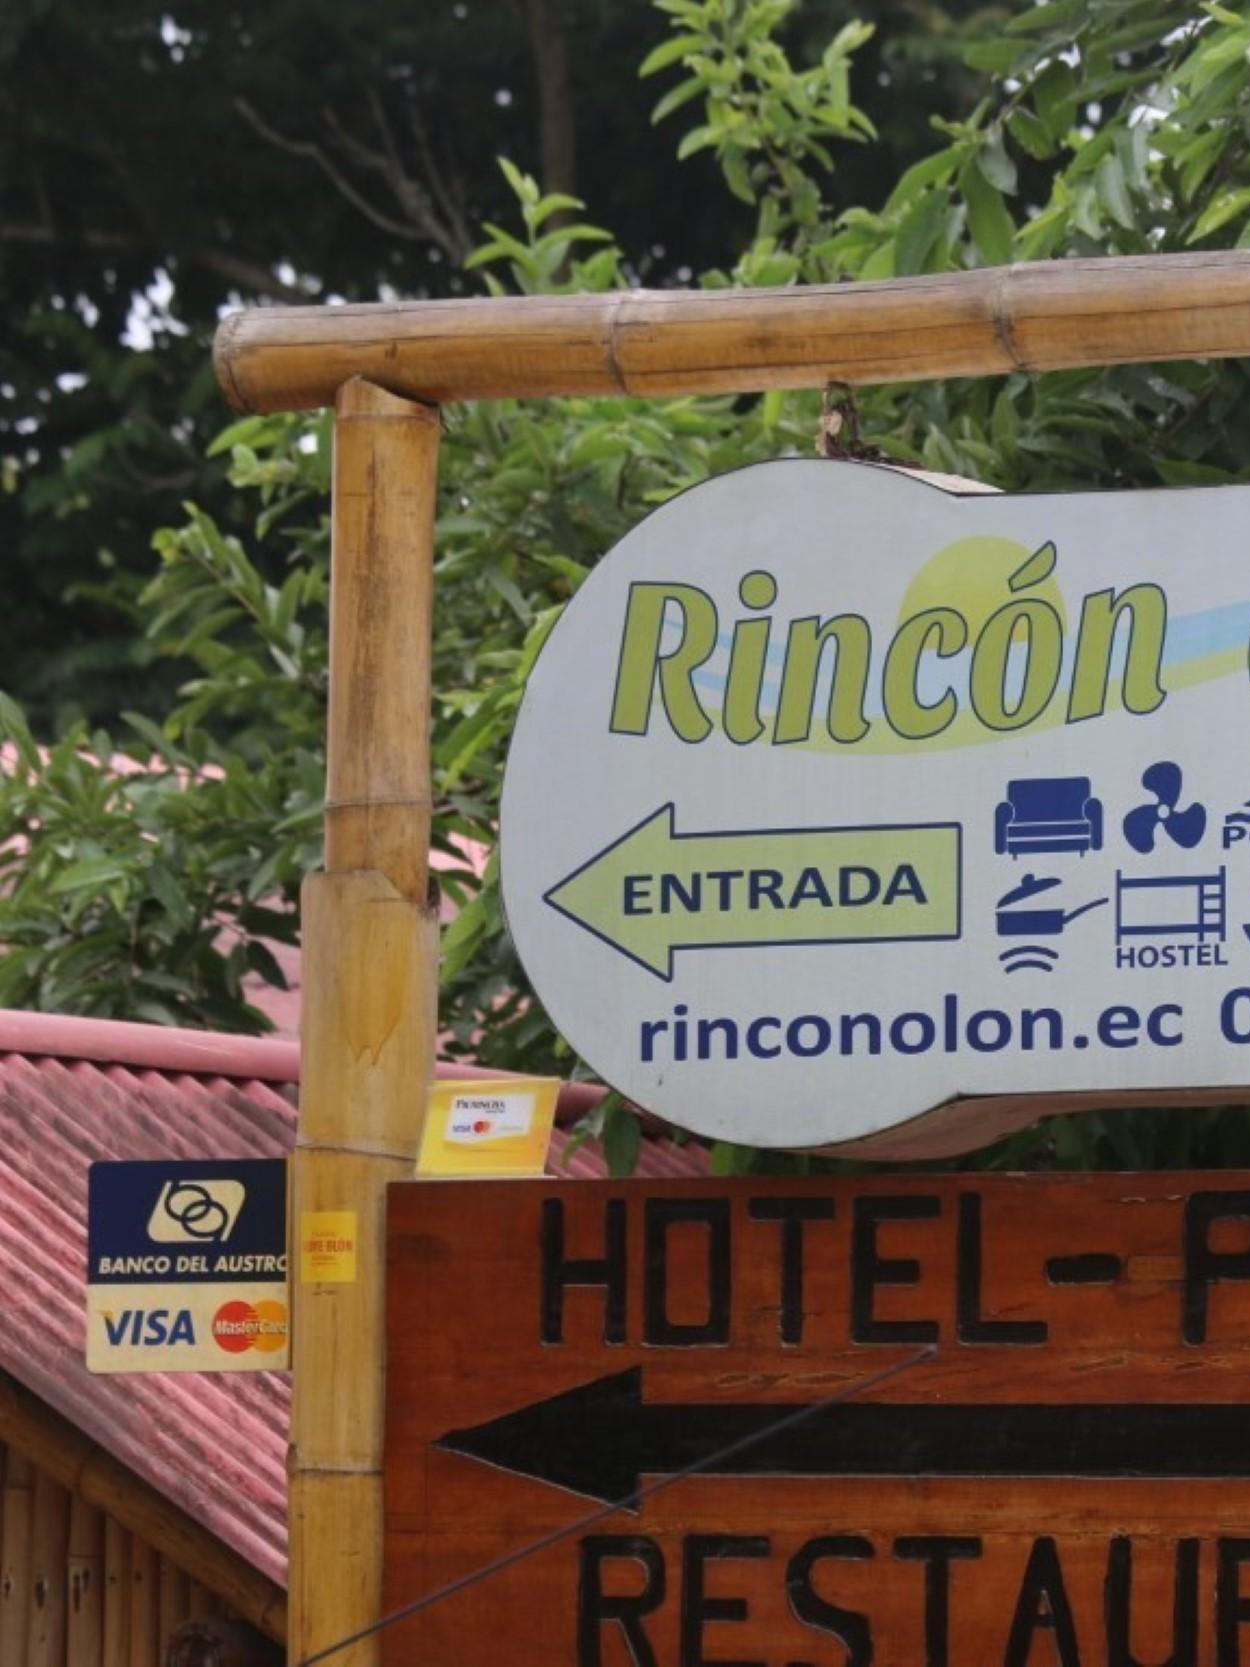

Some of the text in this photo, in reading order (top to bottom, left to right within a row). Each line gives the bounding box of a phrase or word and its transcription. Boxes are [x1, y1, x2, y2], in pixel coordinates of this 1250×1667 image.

[609, 539, 1168, 745] Rincón
[622, 863, 929, 916] ENTRADA
[1115, 943, 1230, 969] HOSTEL
[639, 993, 1185, 1063] rinconolon.ec
[98, 1255, 171, 1274] BANCO
[176, 1255, 210, 1273] DEL
[540, 1191, 1049, 1347] HOTEL
[98, 1309, 195, 1346] VISA
